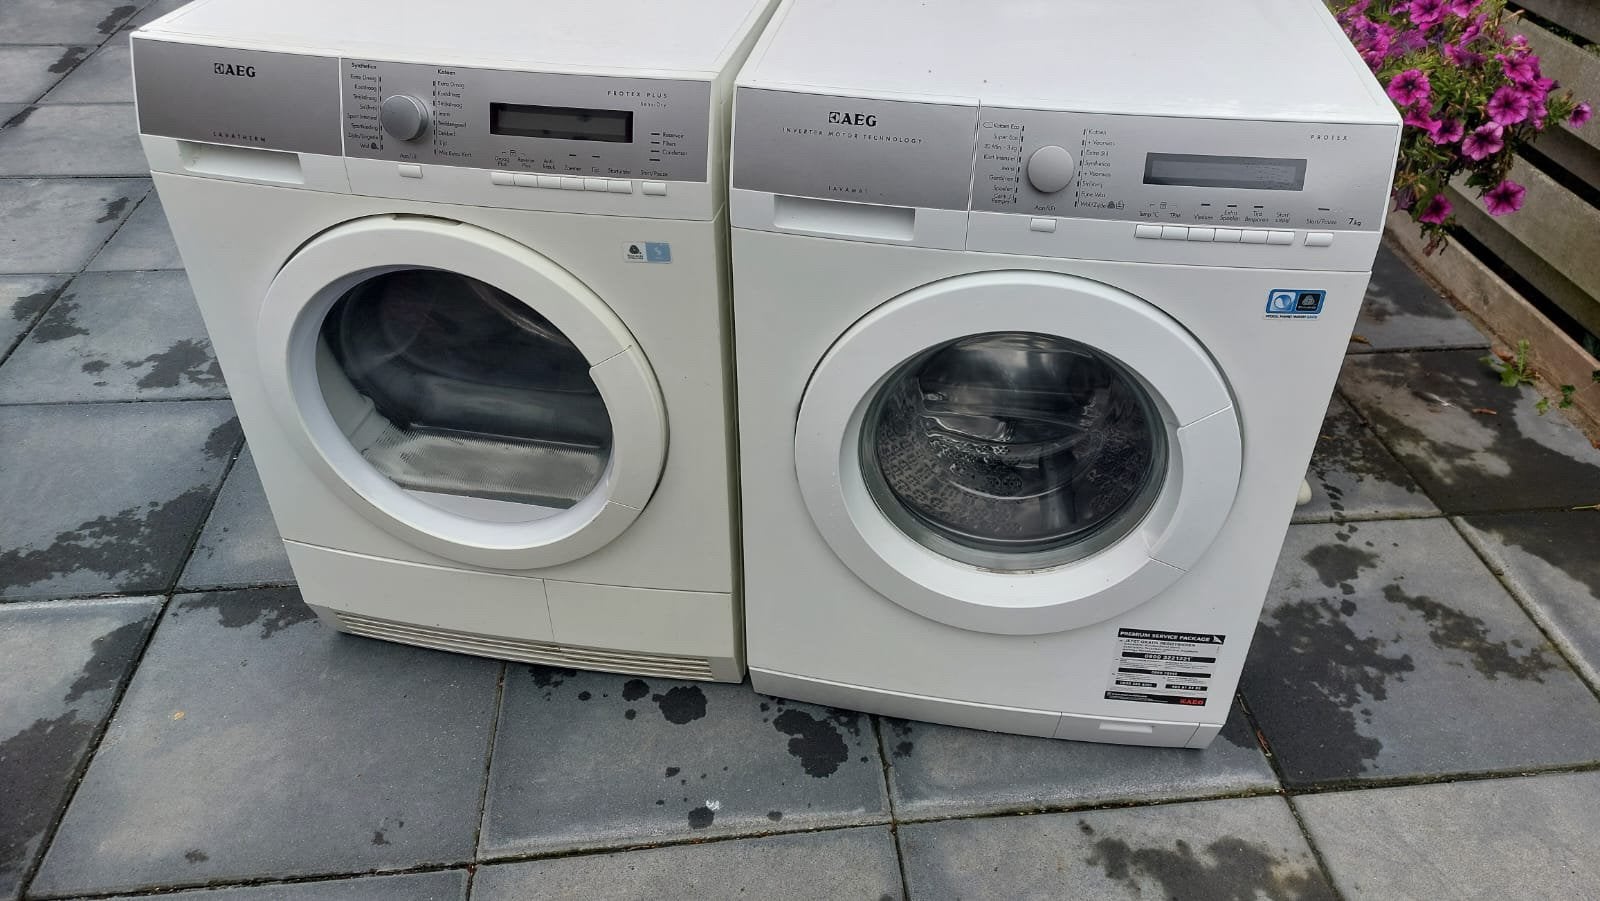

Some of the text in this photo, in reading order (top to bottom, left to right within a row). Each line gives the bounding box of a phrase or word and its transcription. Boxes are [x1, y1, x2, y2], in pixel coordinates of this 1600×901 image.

[225, 64, 256, 78] AEG
[607, 90, 641, 98] PROTEX
[840, 112, 878, 127] AEG
[213, 131, 266, 142] LAVATHERM
[782, 127, 923, 145] INVERTER MOTOR TECHNOLOGY
[1119, 631, 1151, 639] PREMIUM
[1151, 633, 1179, 641] SERVICE
